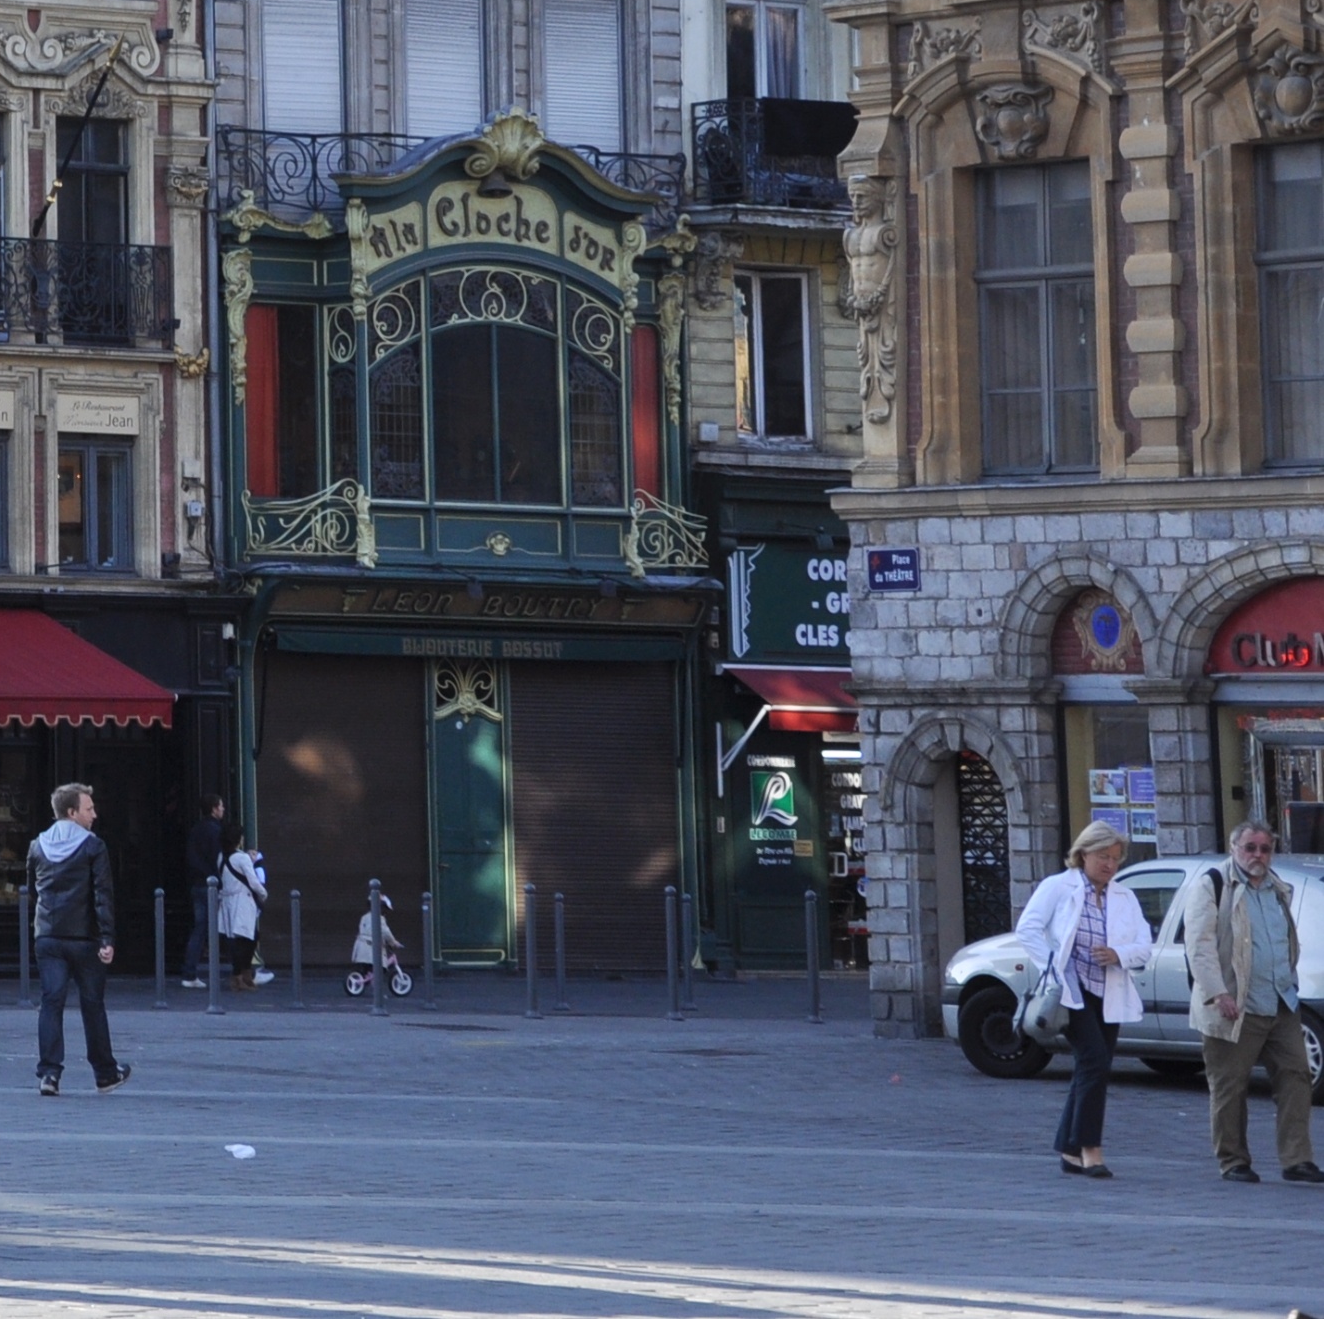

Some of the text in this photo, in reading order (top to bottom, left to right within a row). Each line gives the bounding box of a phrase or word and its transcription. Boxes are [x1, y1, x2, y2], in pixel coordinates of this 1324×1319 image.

[436, 192, 551, 244] Cloche
[81, 400, 125, 412] Restaurant
[105, 413, 134, 428] Jean
[892, 554, 910, 565] Place
[807, 558, 848, 581] COR
[875, 574, 883, 583] du
[795, 623, 839, 647] CLES
[402, 637, 492, 657] BIJOUTERIE
[1232, 632, 1310, 668] Club
[749, 827, 797, 841] LECOMTE
